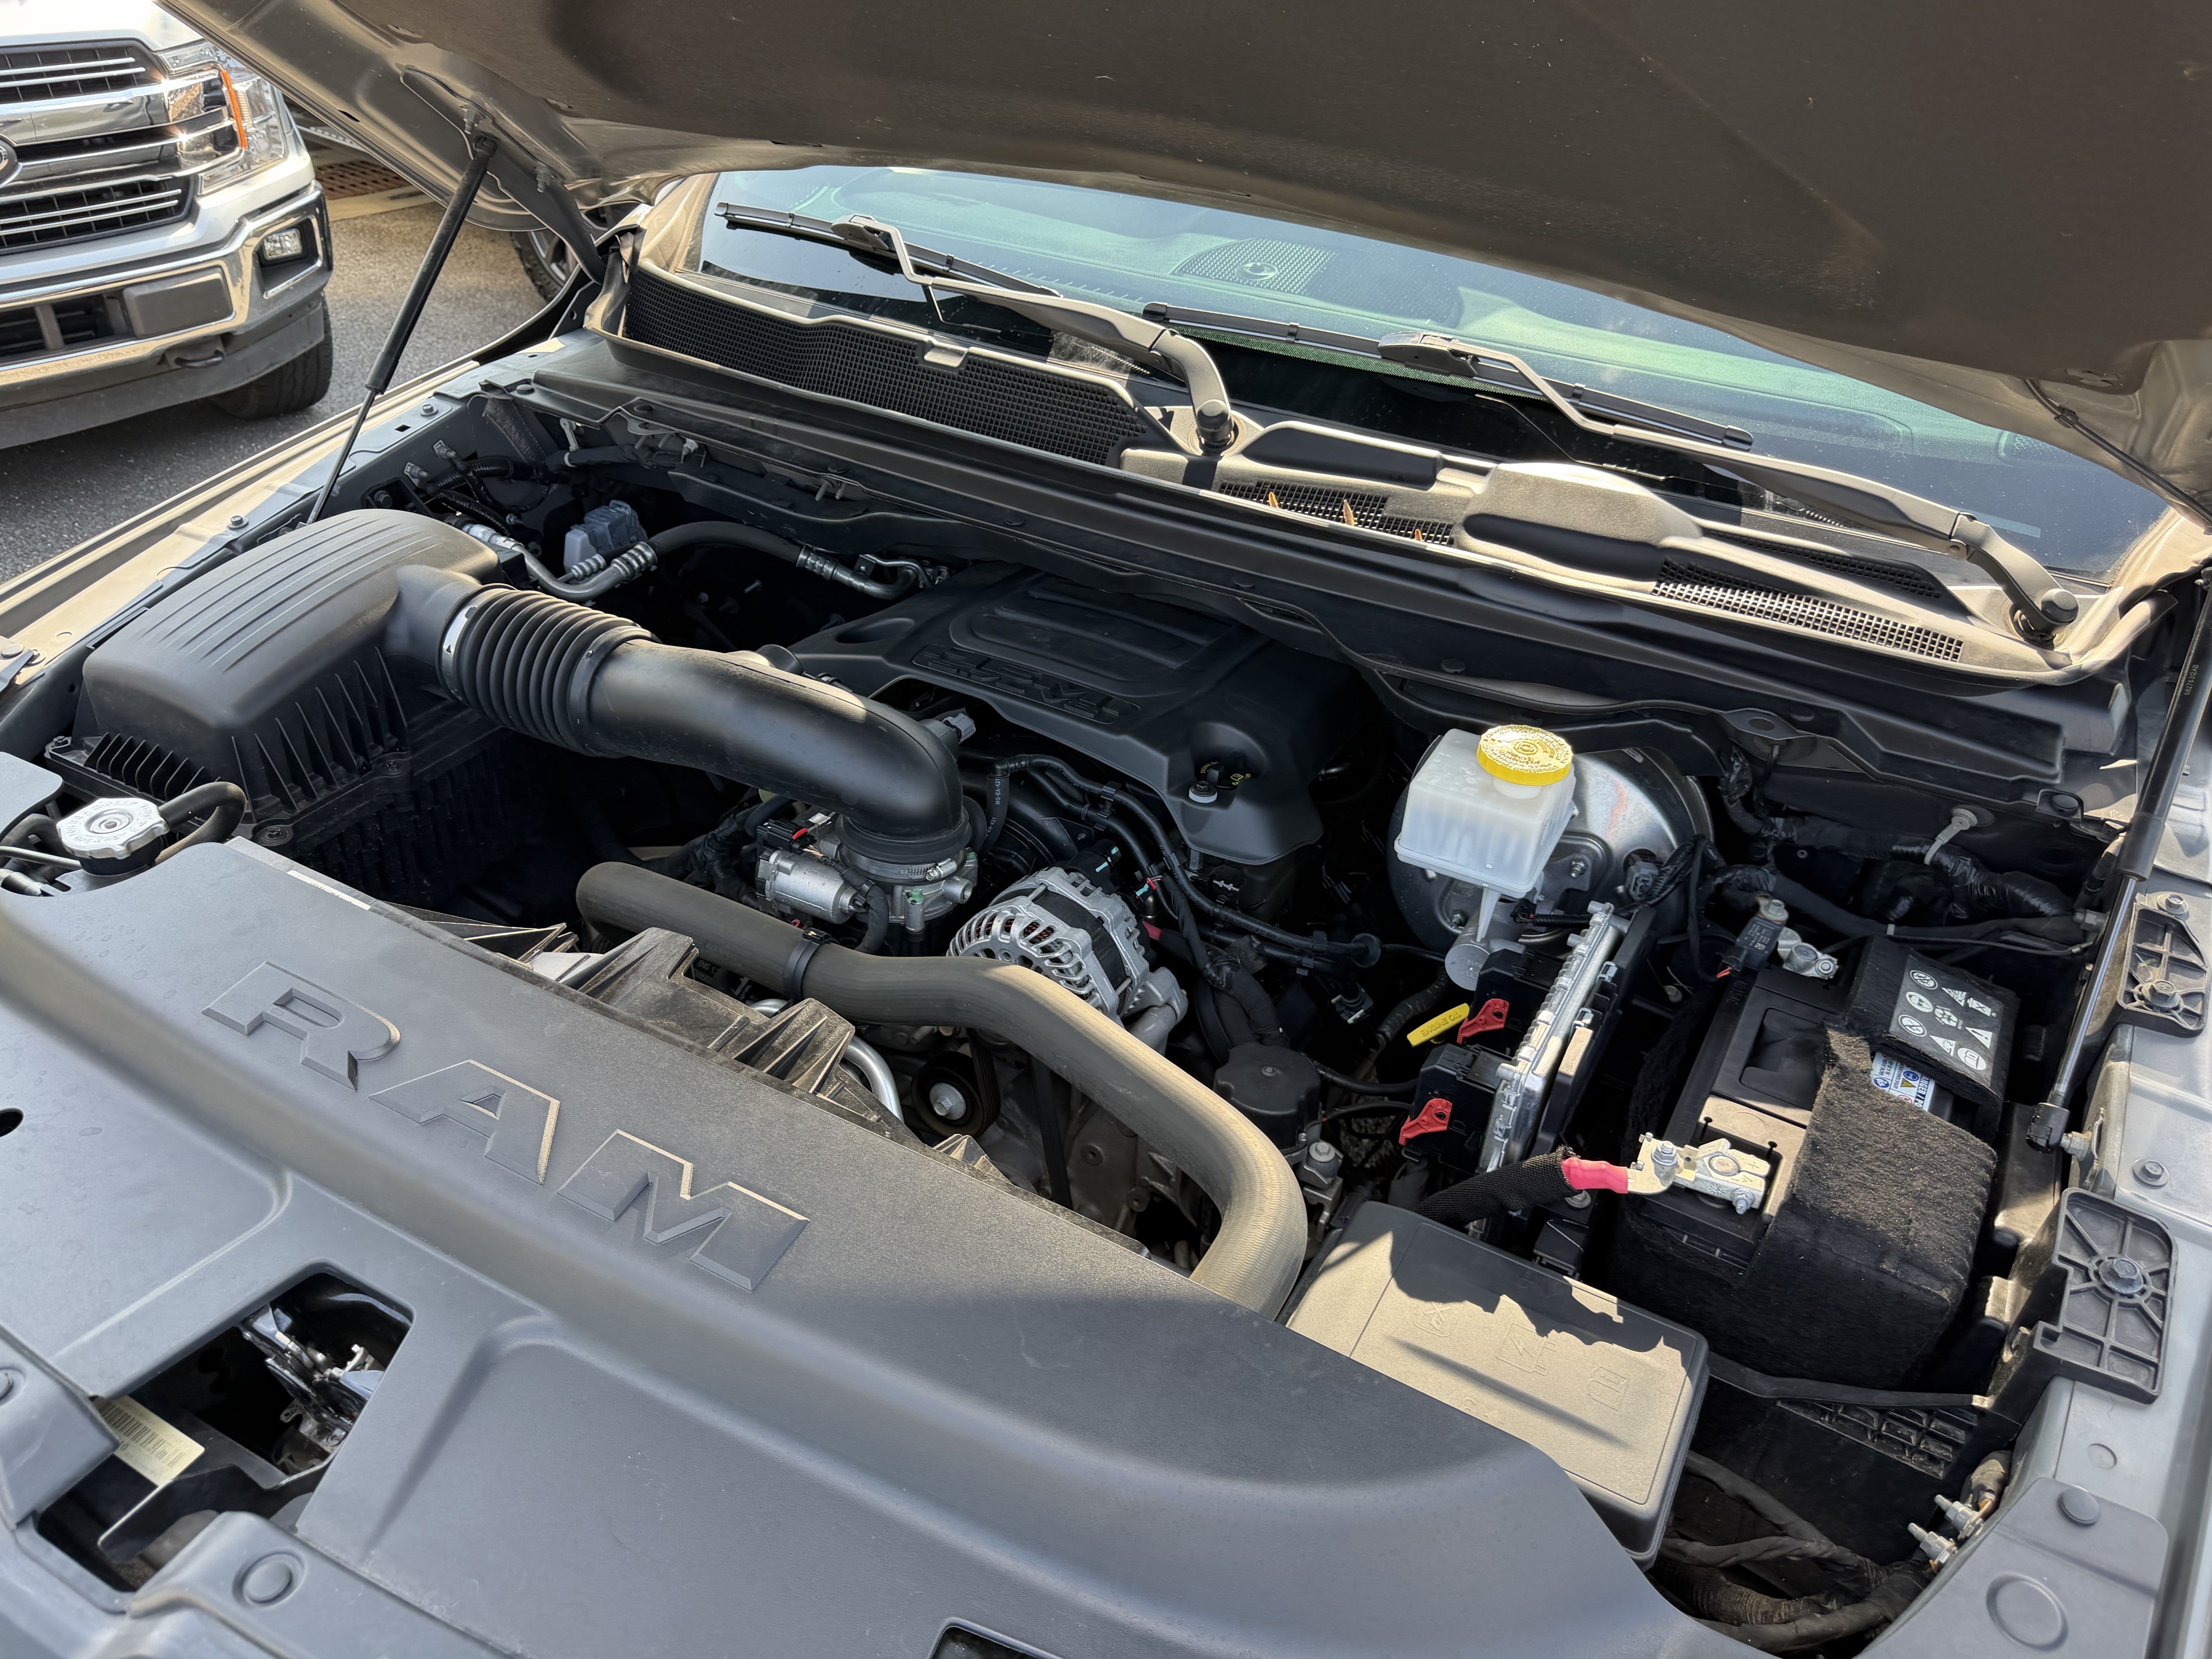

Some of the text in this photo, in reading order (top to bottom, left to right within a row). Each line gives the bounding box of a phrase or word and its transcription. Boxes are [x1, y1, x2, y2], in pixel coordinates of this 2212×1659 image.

[1420, 1011, 1462, 1037] ENGINE OIL
[1917, 1075, 1930, 1094] ANGER
[202, 962, 809, 1291] RAM
